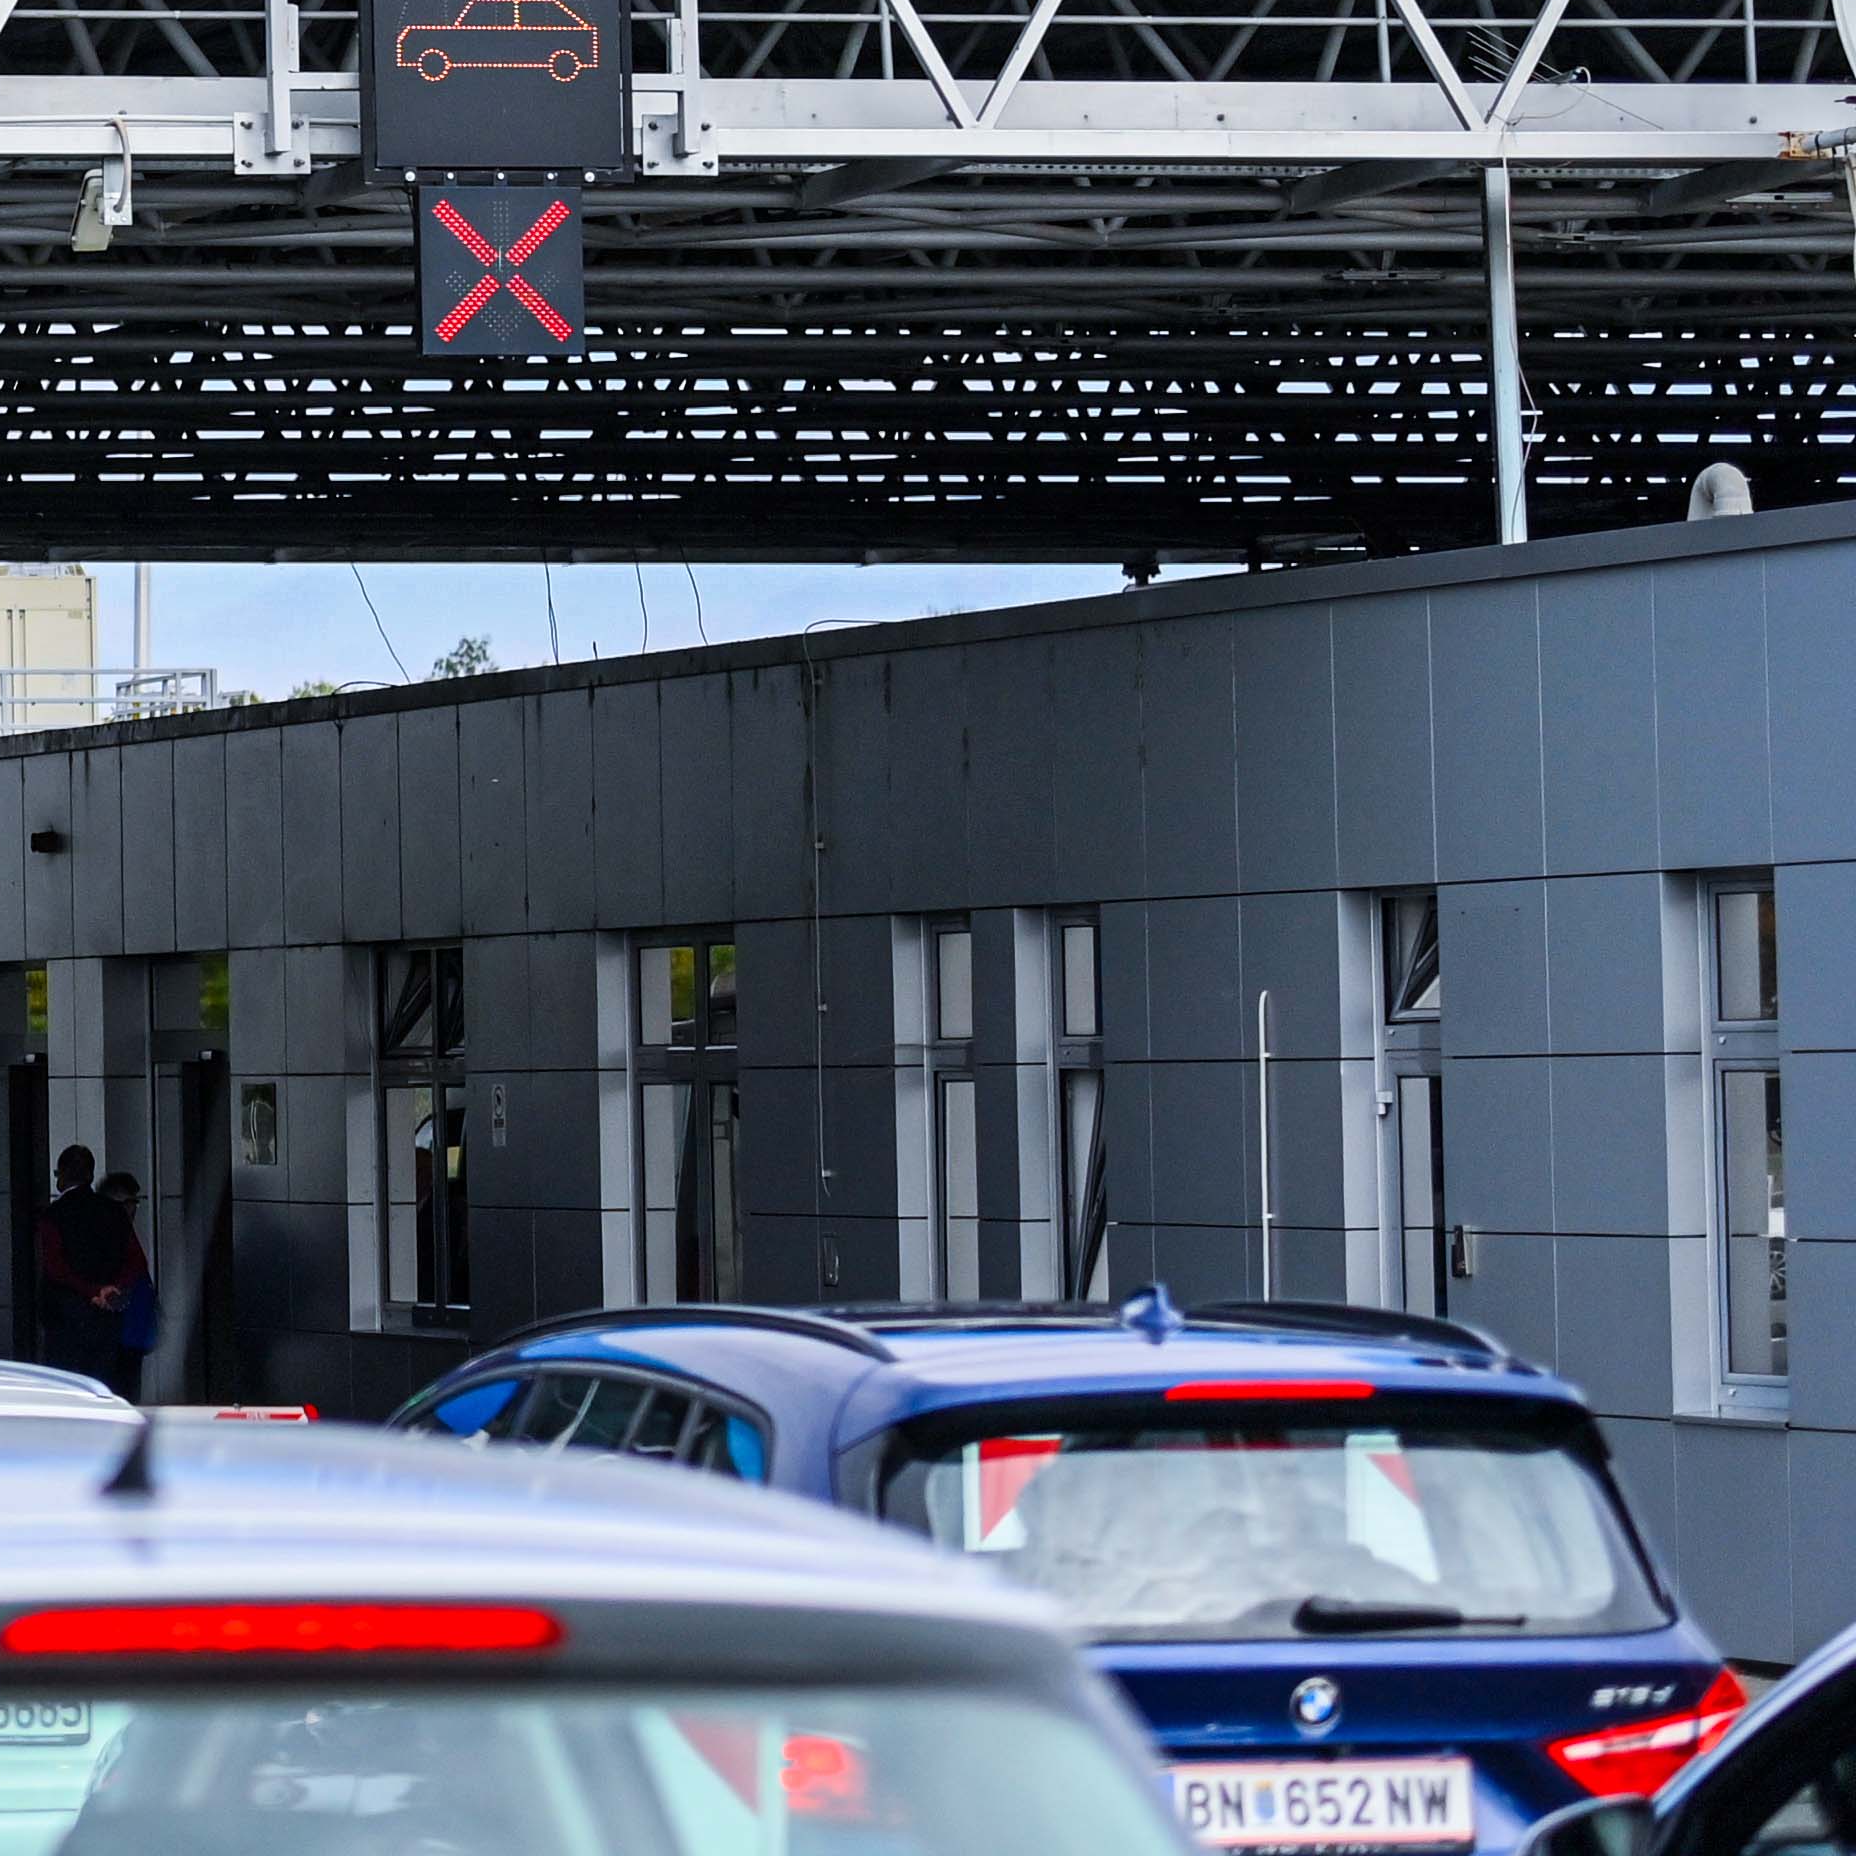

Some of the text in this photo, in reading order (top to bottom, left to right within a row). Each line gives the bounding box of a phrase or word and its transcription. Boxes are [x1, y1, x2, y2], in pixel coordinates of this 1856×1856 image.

[1184, 1776, 1450, 1831] BN 652 NW
